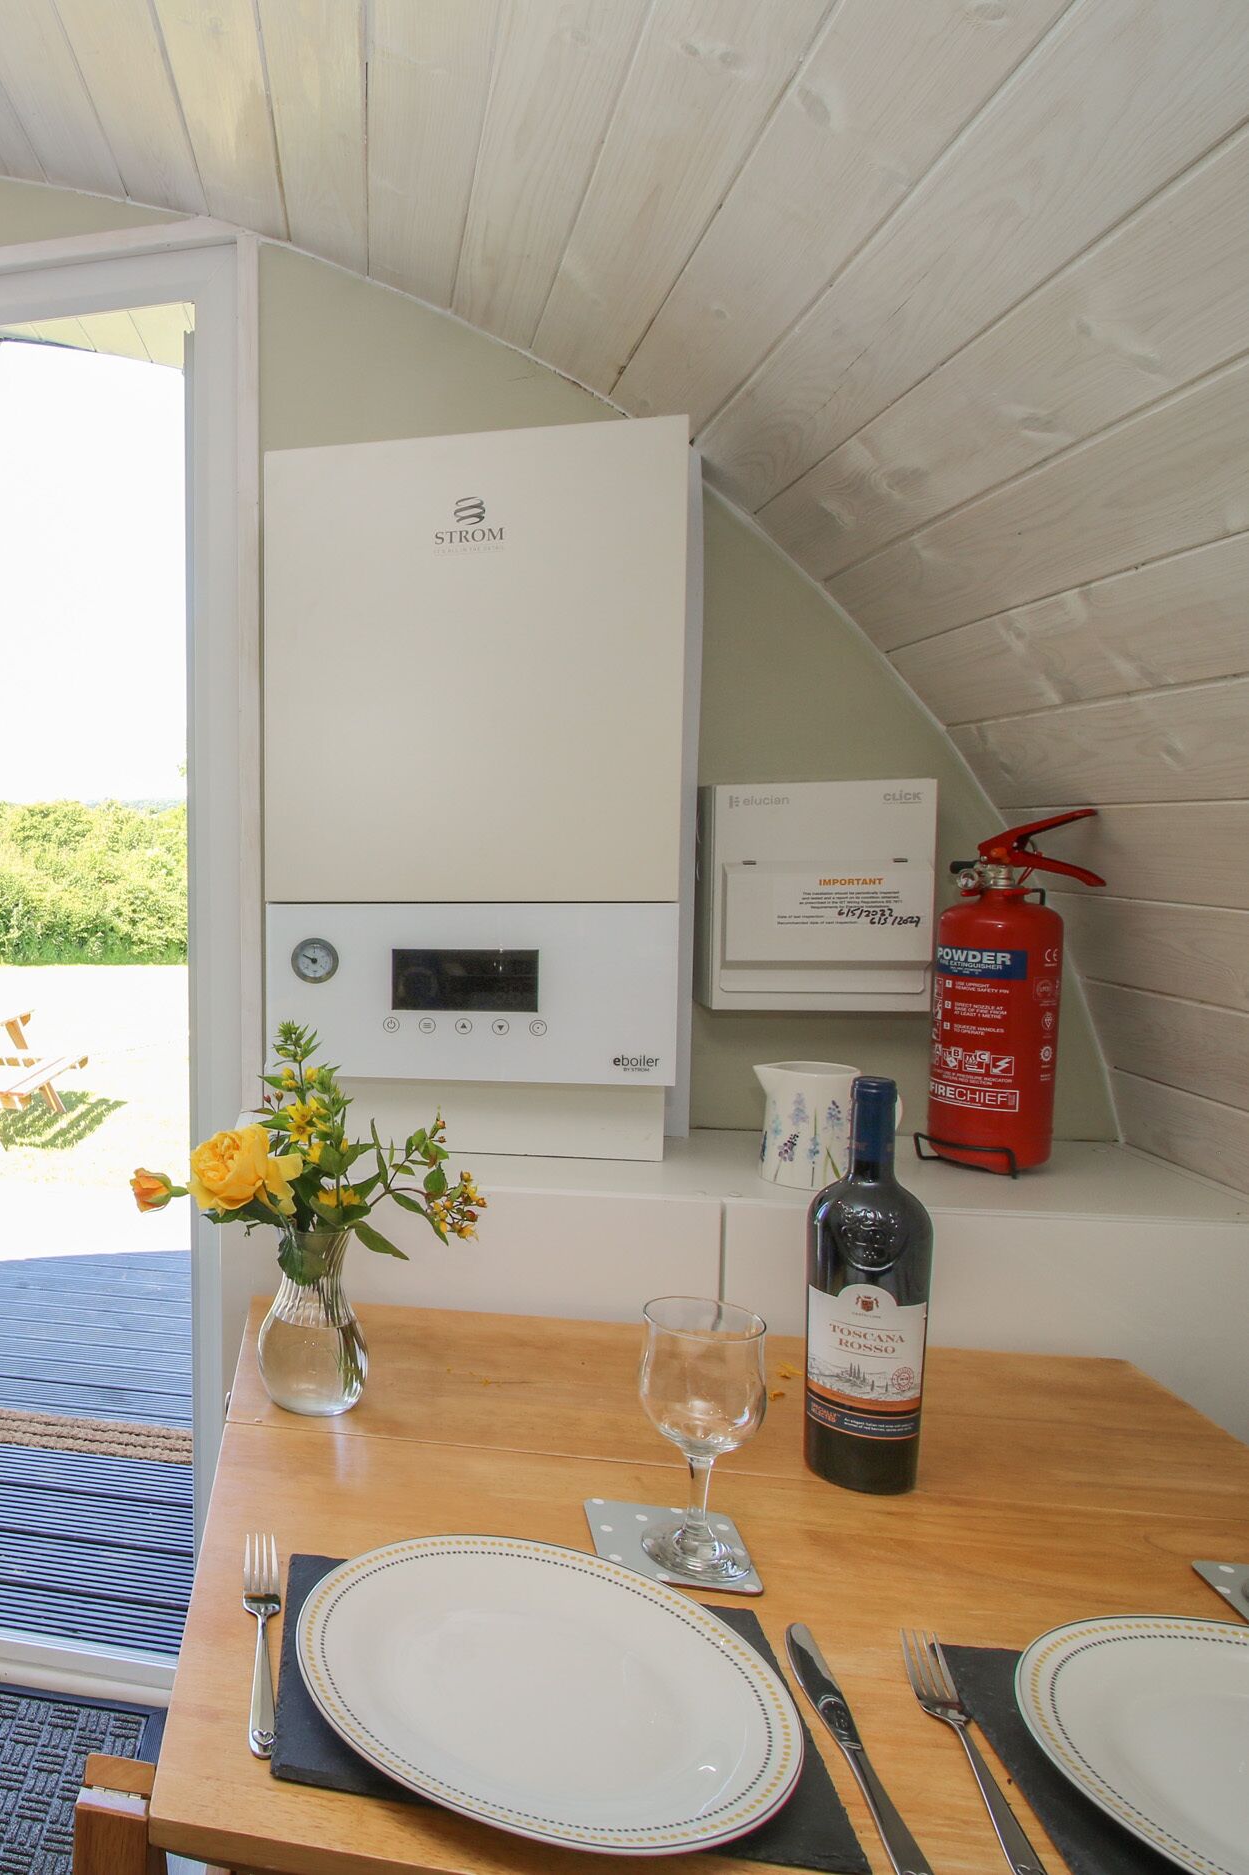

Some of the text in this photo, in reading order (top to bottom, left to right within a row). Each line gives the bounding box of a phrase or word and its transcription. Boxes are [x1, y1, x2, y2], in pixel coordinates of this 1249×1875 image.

[434, 527, 505, 545] STROM
[742, 795, 790, 806] elucian
[819, 878, 884, 886] IMPORTANT
[937, 947, 1012, 965] POWDER
[949, 960, 1003, 970] EXTINGUISHER
[613, 1054, 660, 1067] eboiler
[979, 1052, 987, 1060] C
[930, 1081, 1008, 1105] FIRECHIEF
[829, 1323, 905, 1343] TOSCANA
[838, 1337, 896, 1354] ROSSO
